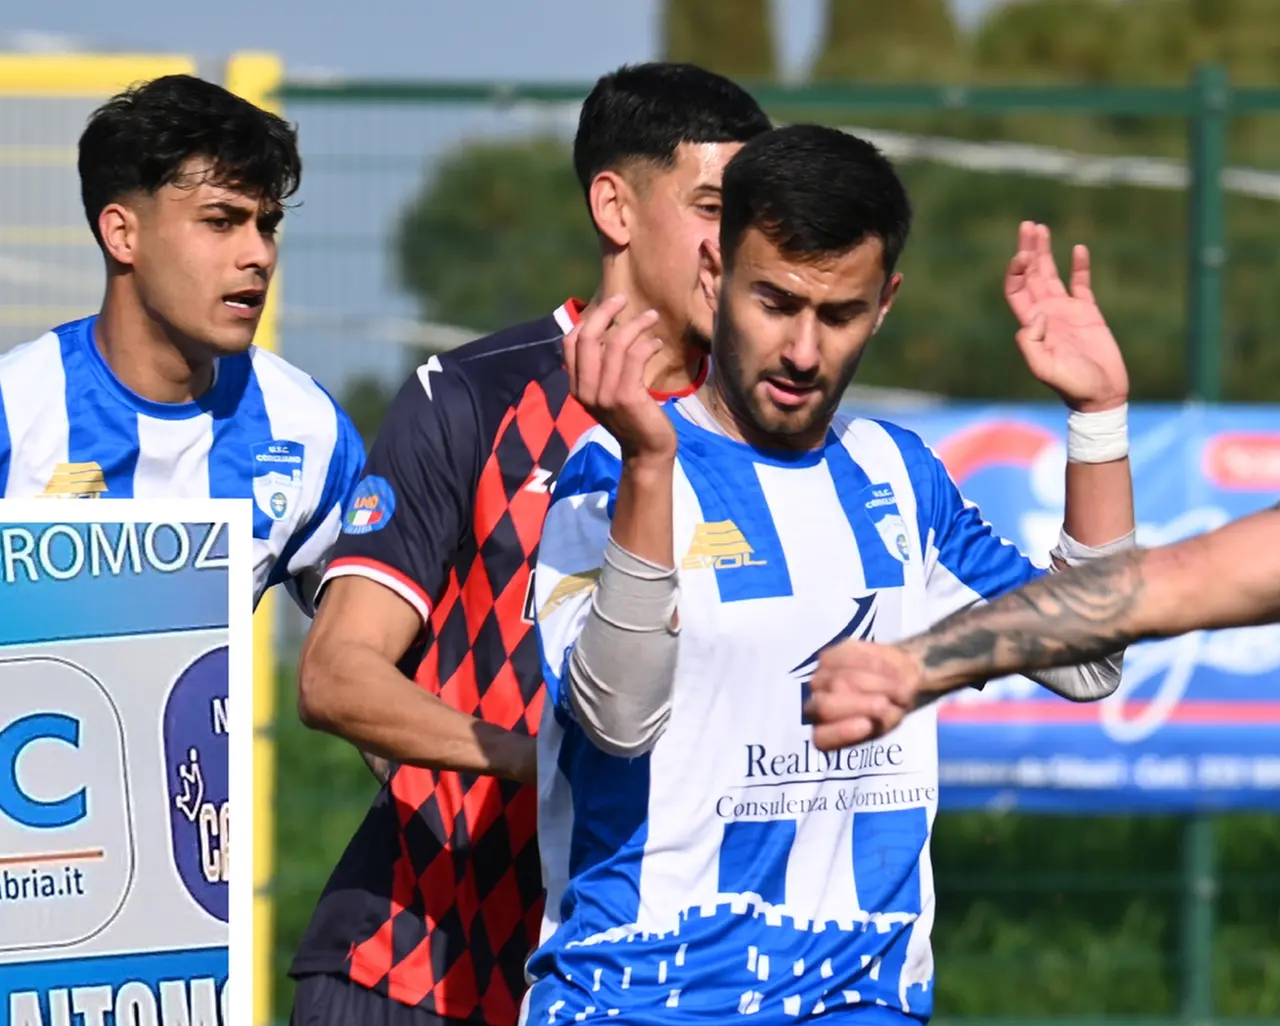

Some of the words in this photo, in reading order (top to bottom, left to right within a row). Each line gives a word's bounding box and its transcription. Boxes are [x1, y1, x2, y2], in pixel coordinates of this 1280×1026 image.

[744, 740, 810, 778] Real
[716, 792, 828, 818] Consulenza
[835, 788, 849, 811] &
